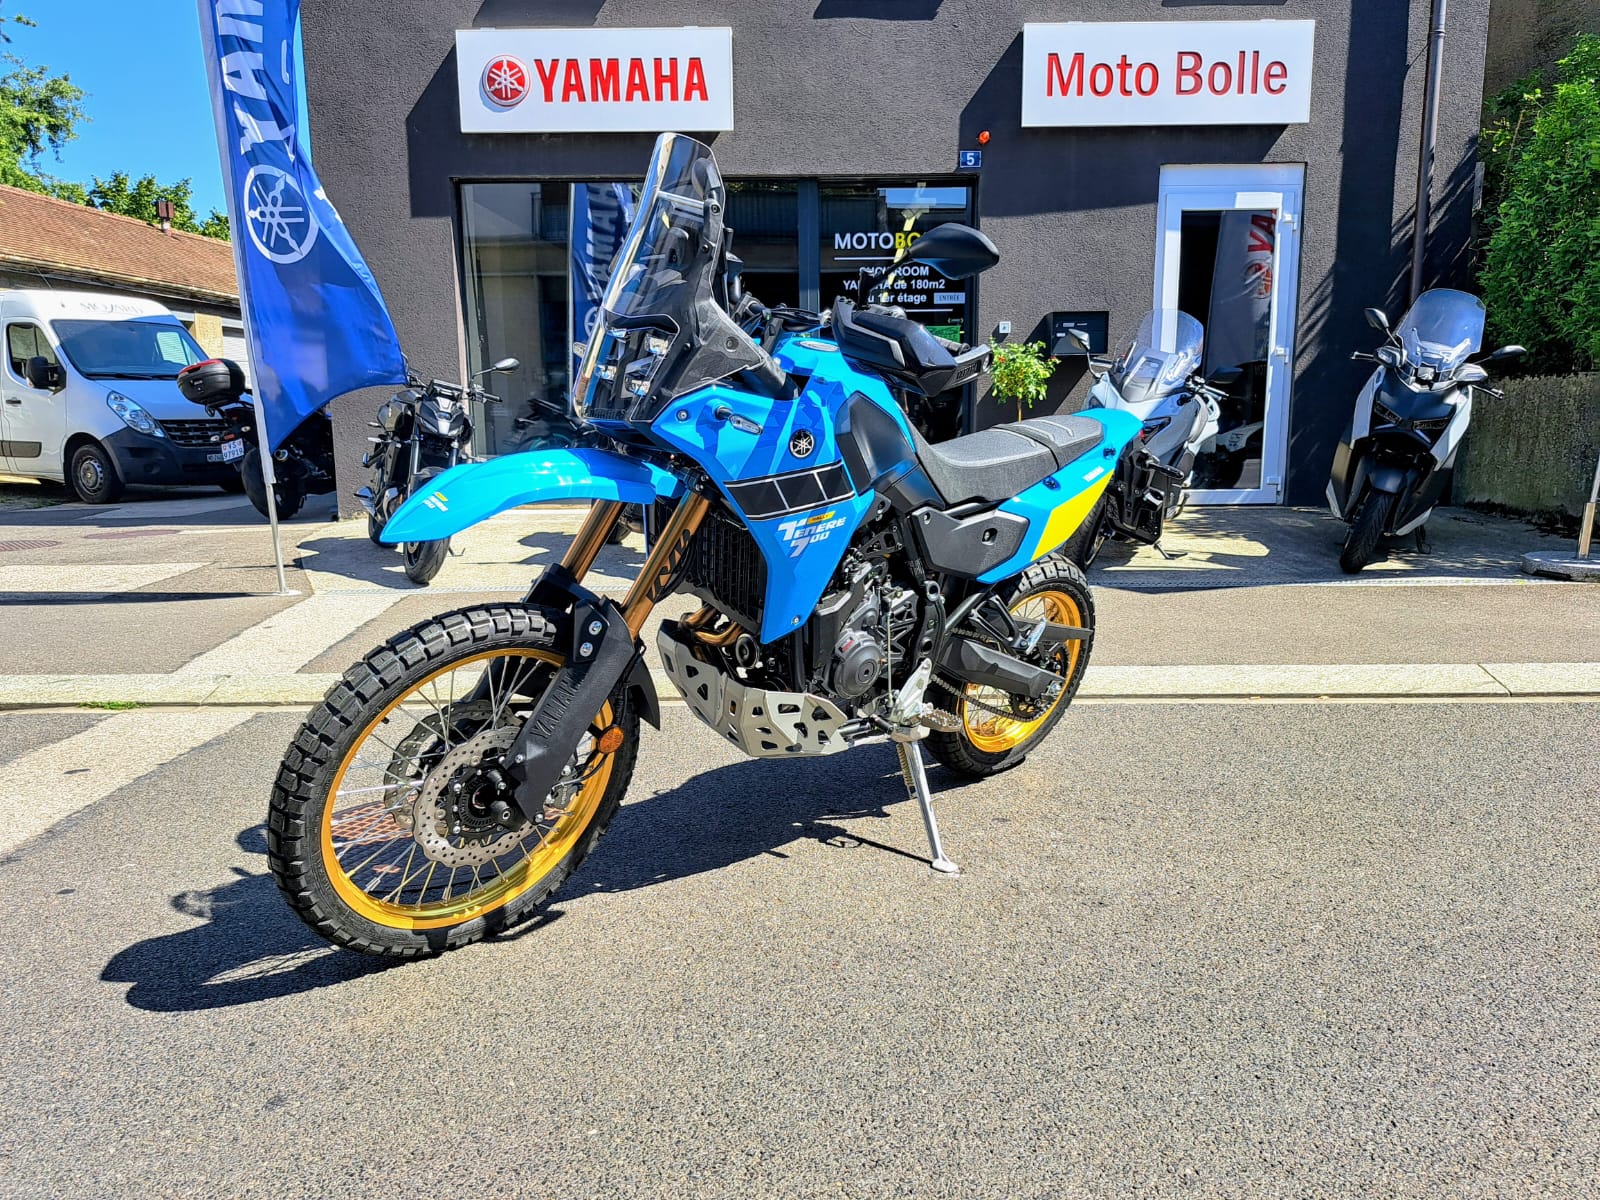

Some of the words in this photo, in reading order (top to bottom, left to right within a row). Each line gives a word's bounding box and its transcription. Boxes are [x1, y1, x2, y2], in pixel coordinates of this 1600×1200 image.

[533, 57, 709, 103] YAMAHA
[1045, 52, 1159, 97] Moto
[1175, 50, 1288, 96] Bolle
[966, 152, 975, 166] 5
[893, 280, 907, 290] de
[910, 279, 946, 290] 180m2
[897, 292, 927, 304] étage
[789, 531, 831, 558] 700
